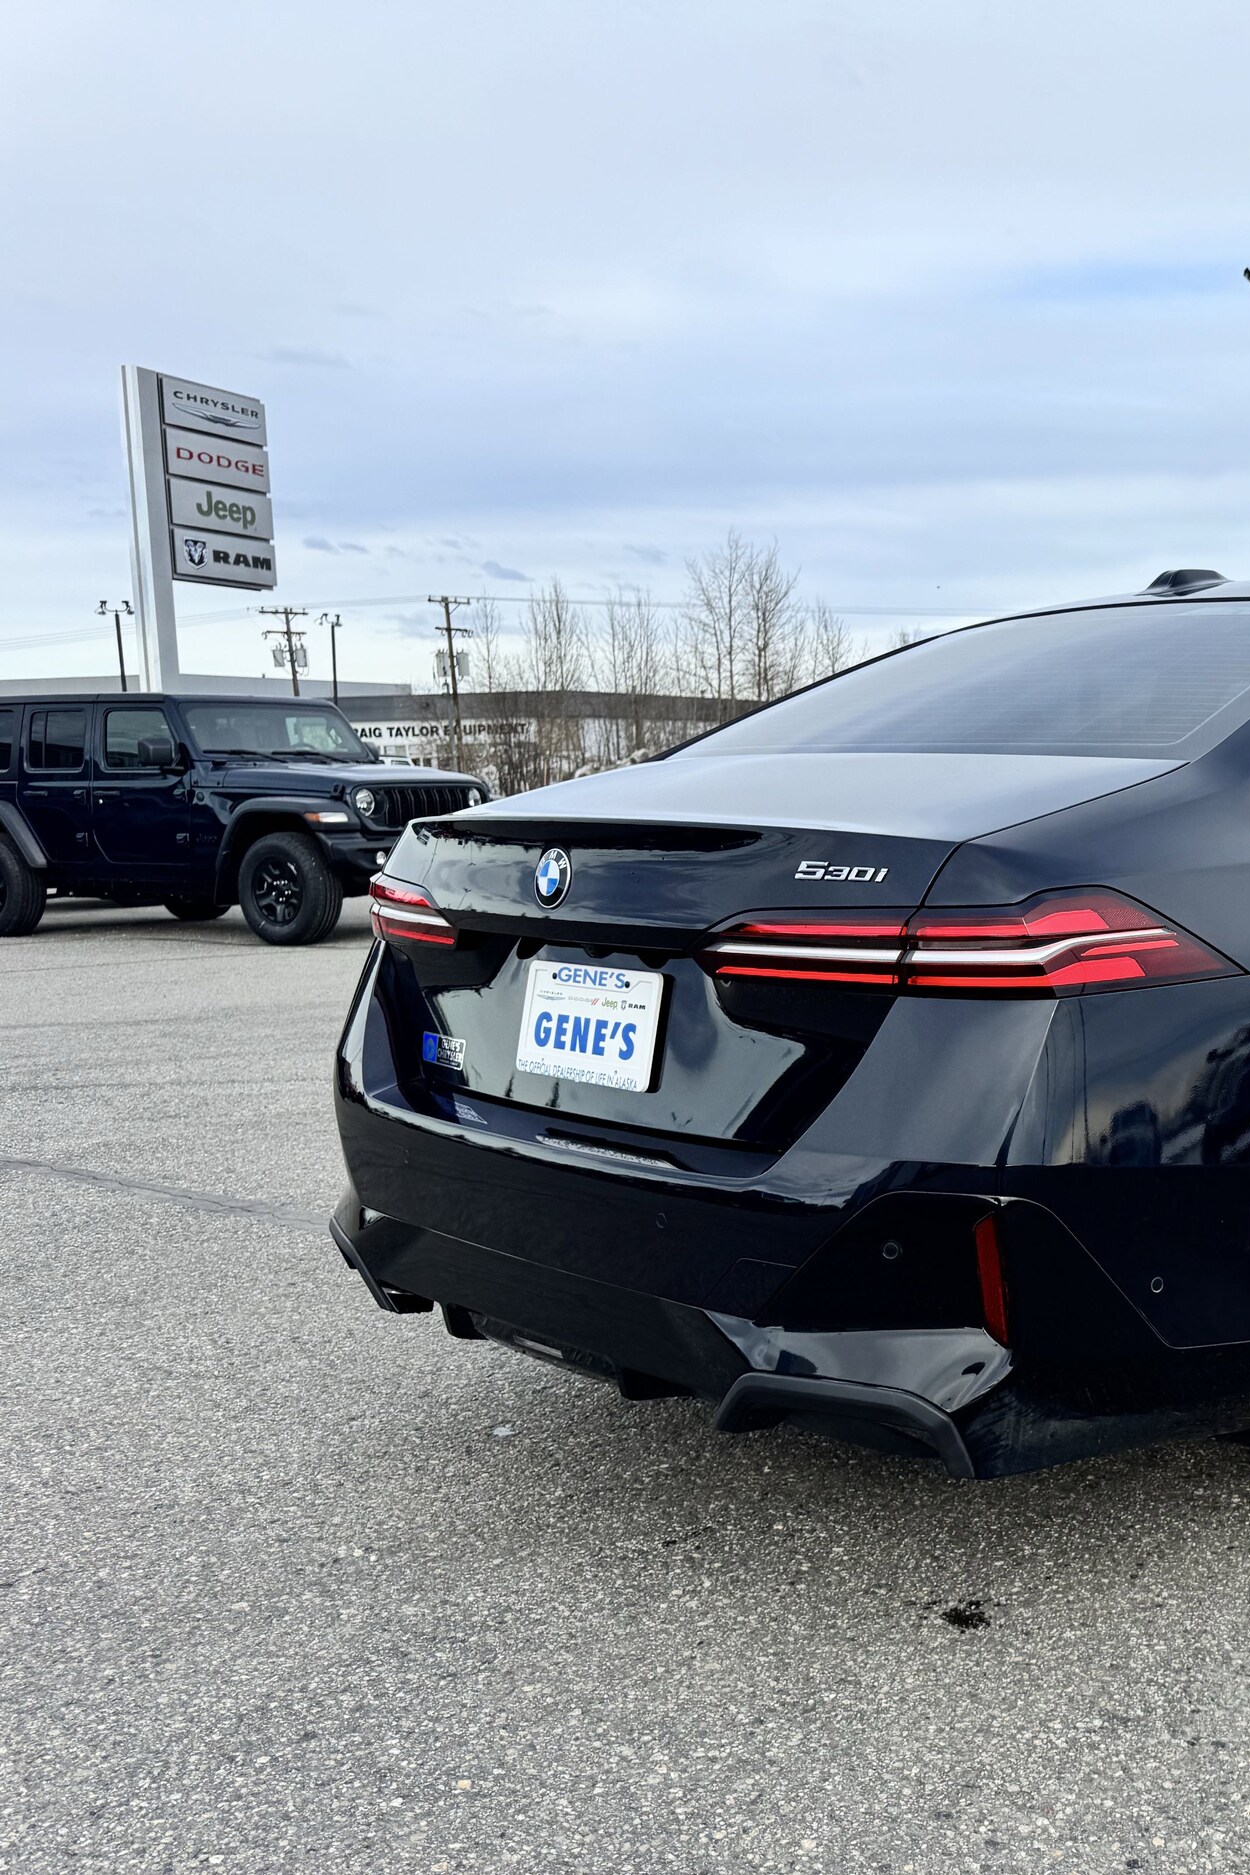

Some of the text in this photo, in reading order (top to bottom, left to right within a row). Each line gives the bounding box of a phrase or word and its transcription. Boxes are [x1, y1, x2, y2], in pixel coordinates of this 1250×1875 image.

[173, 390, 259, 419] CHRYSLER
[176, 447, 264, 477] DODGE
[196, 491, 256, 530] Jeep
[213, 549, 272, 571] RAM
[387, 725, 440, 738] TAYLOR
[794, 860, 889, 882] 530i
[557, 966, 627, 989] GENE'S
[601, 997, 618, 1010] Jeep
[628, 1003, 646, 1011] RAM
[534, 1011, 637, 1061] GENE'S
[552, 1064, 585, 1080] DEALERSHIP
